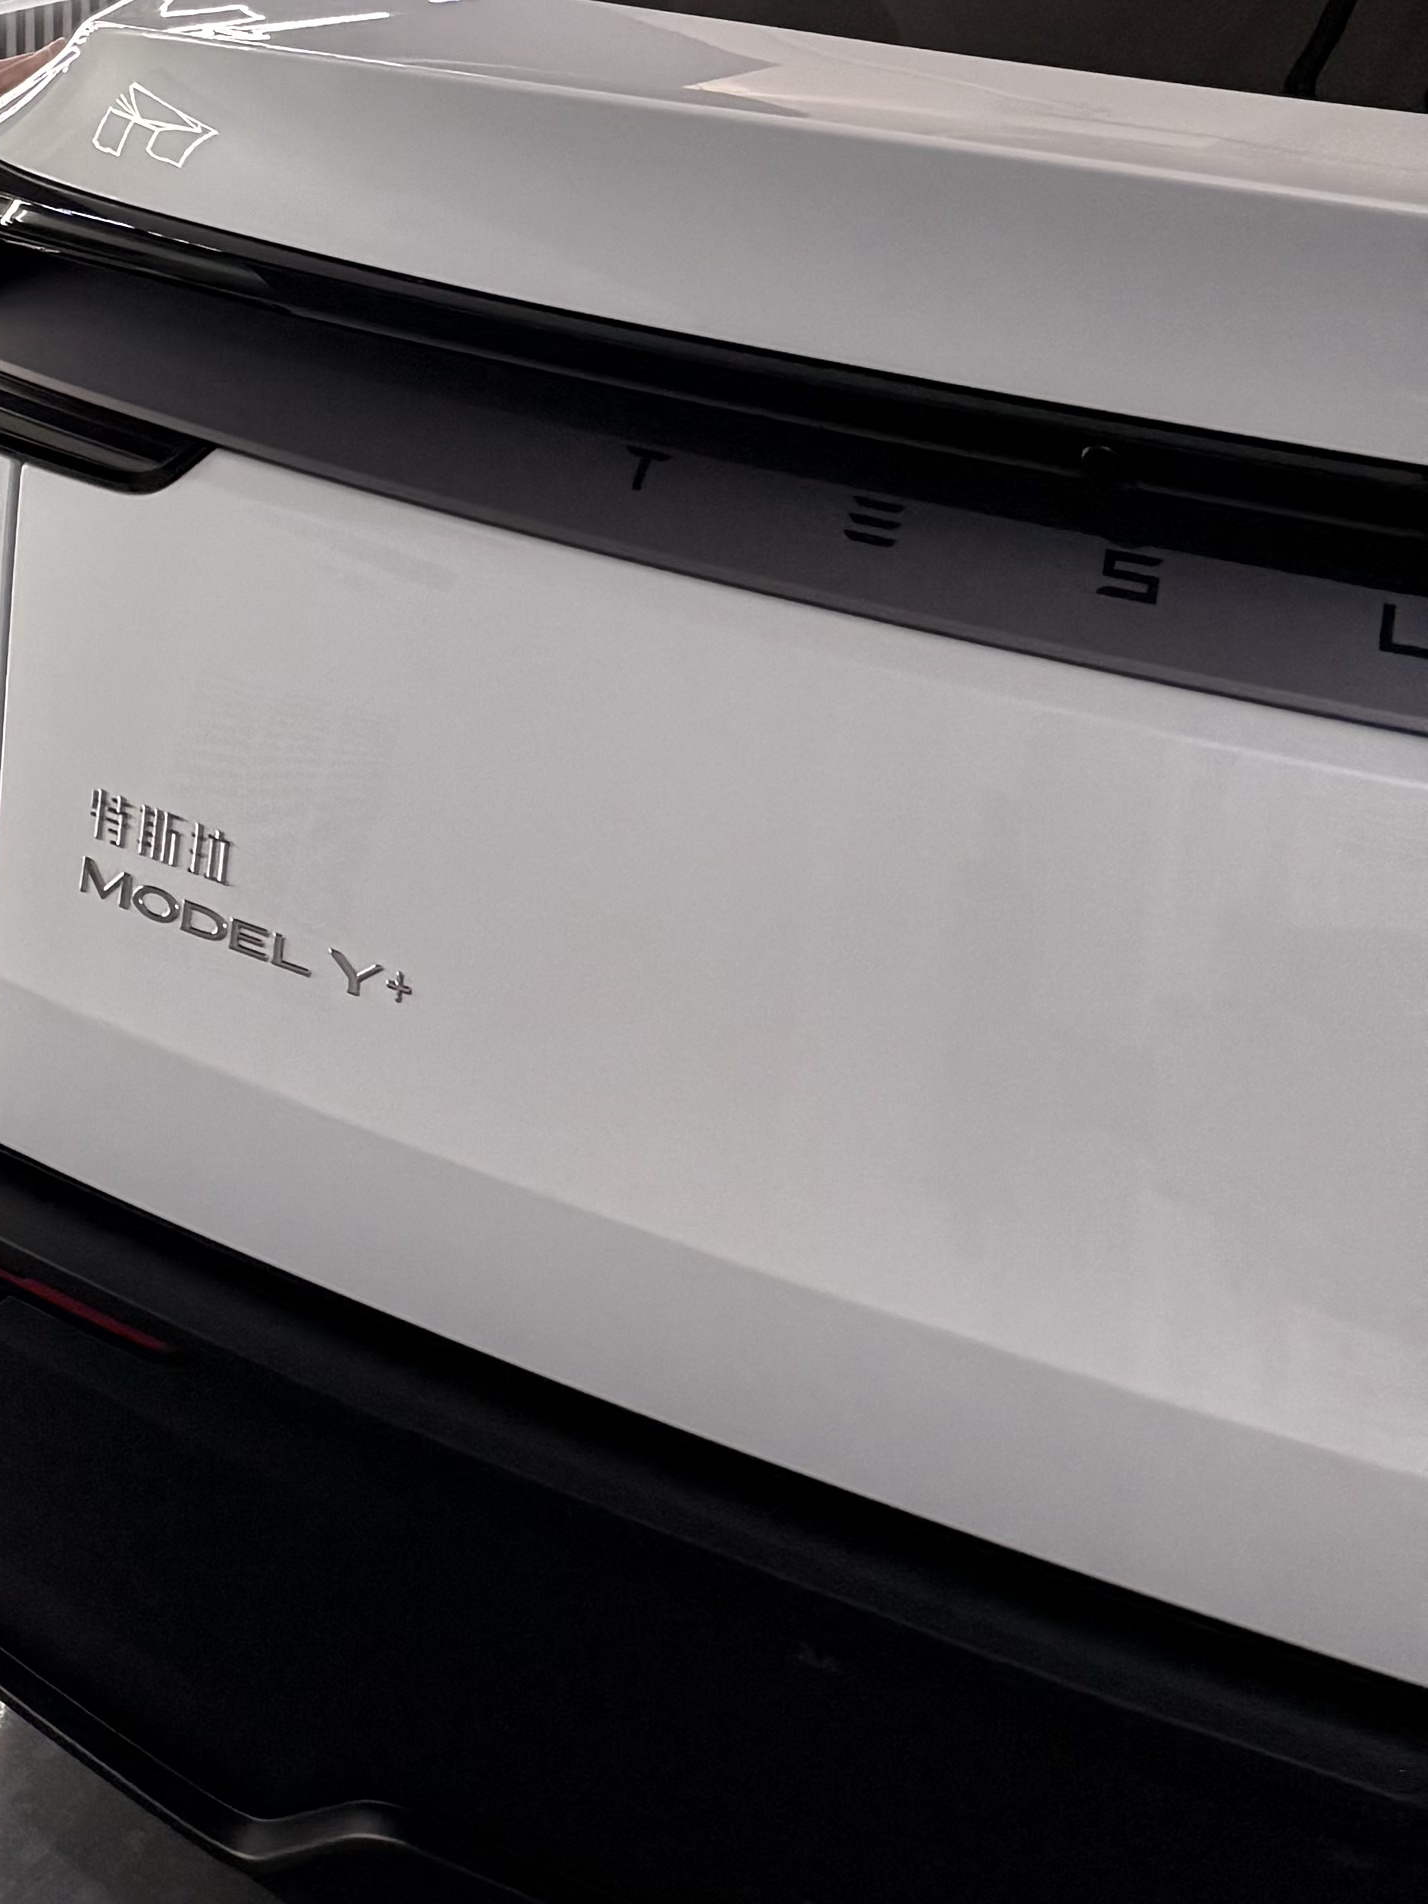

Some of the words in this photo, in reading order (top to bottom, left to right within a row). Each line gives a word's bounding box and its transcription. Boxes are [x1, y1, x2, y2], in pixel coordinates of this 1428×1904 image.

[90, 787, 235, 887] 特斯拉
[79, 854, 312, 978] MODEL
[327, 946, 413, 1003] Y+
